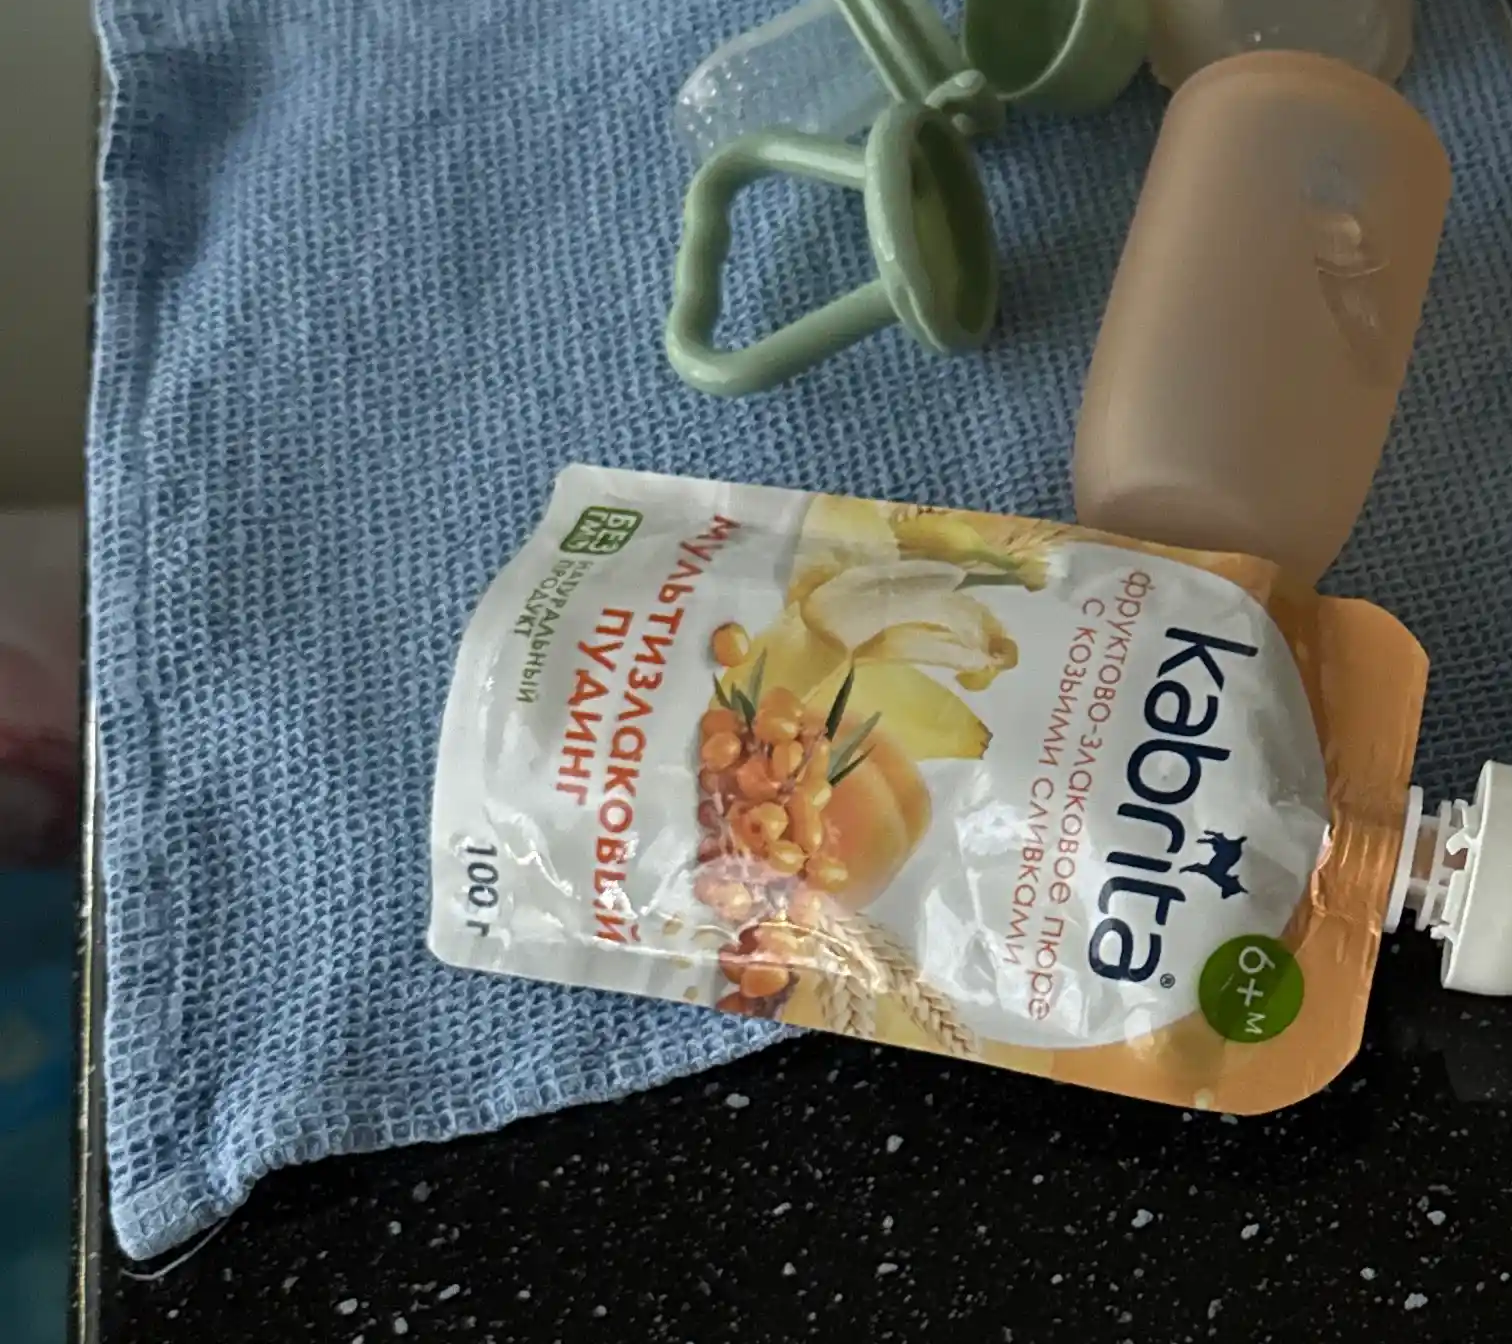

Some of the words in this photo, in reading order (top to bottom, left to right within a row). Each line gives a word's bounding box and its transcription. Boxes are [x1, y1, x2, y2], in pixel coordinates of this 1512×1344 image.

[513, 558, 575, 638] ПРОДУКТ
[516, 558, 595, 704] НАТУРАЛЬНЫЙ
[466, 842, 500, 909] 100
